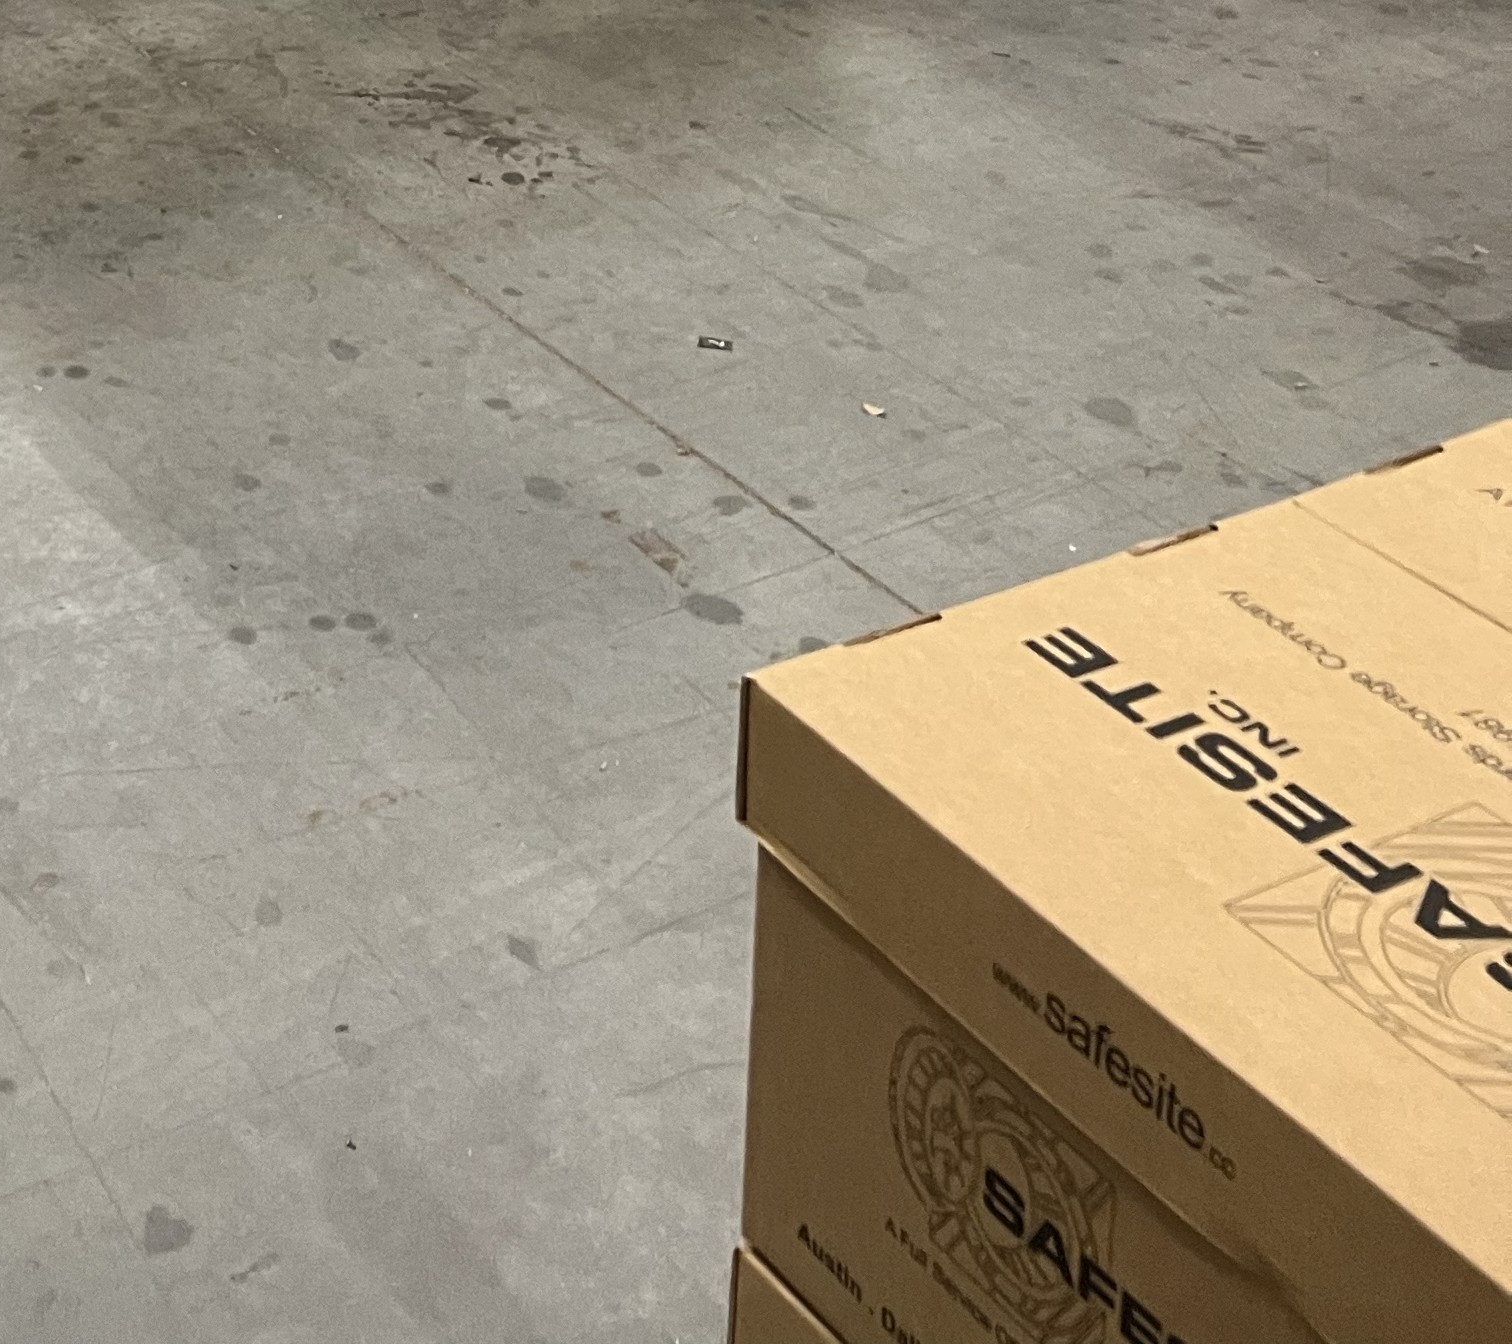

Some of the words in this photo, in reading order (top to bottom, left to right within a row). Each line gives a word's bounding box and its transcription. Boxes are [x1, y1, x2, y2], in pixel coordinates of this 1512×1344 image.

[1219, 589, 1347, 670] Company
[1207, 690, 1300, 759] INC.
[1350, 671, 1462, 744] Storage
[1021, 626, 1512, 992] AFESITE
[796, 1223, 863, 1305] Austin
[982, 1166, 1187, 1344] SAFE
